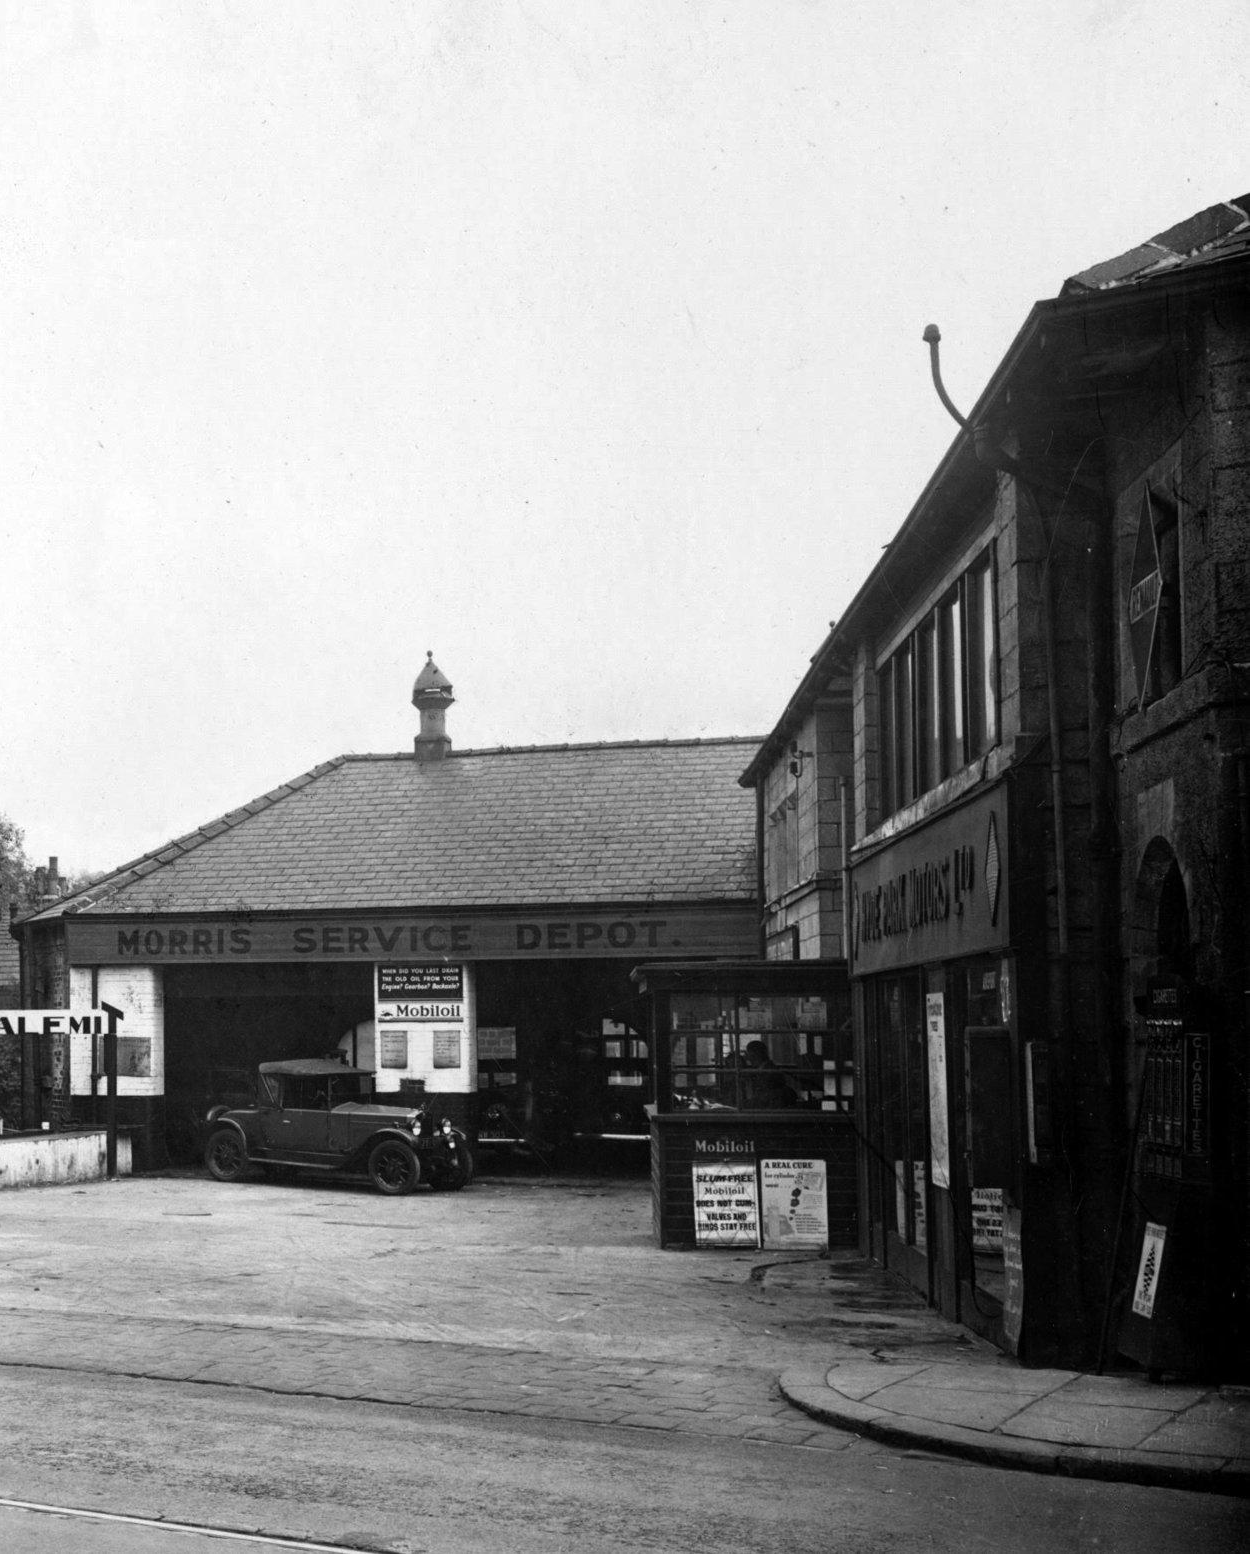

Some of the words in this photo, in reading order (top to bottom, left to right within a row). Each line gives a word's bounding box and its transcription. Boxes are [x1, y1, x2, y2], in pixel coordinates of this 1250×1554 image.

[117, 929, 252, 955] MORRIS
[293, 925, 472, 953] SERVICE
[381, 983, 404, 992] Engine?
[395, 1004, 461, 1018] Mobiloil
[1191, 1036, 1204, 1153] CIGARETTES
[695, 1139, 756, 1153] Mobiloil
[704, 1187, 746, 1195] Mobiloil
[695, 1199, 715, 1207] DOES
[717, 1199, 733, 1207] NOT
[706, 1212, 732, 1221] VALVES
[733, 1212, 748, 1221] AND
[698, 1222, 719, 1231] RINGS
[720, 1222, 739, 1231] STAY
[740, 1222, 757, 1231] FREE
